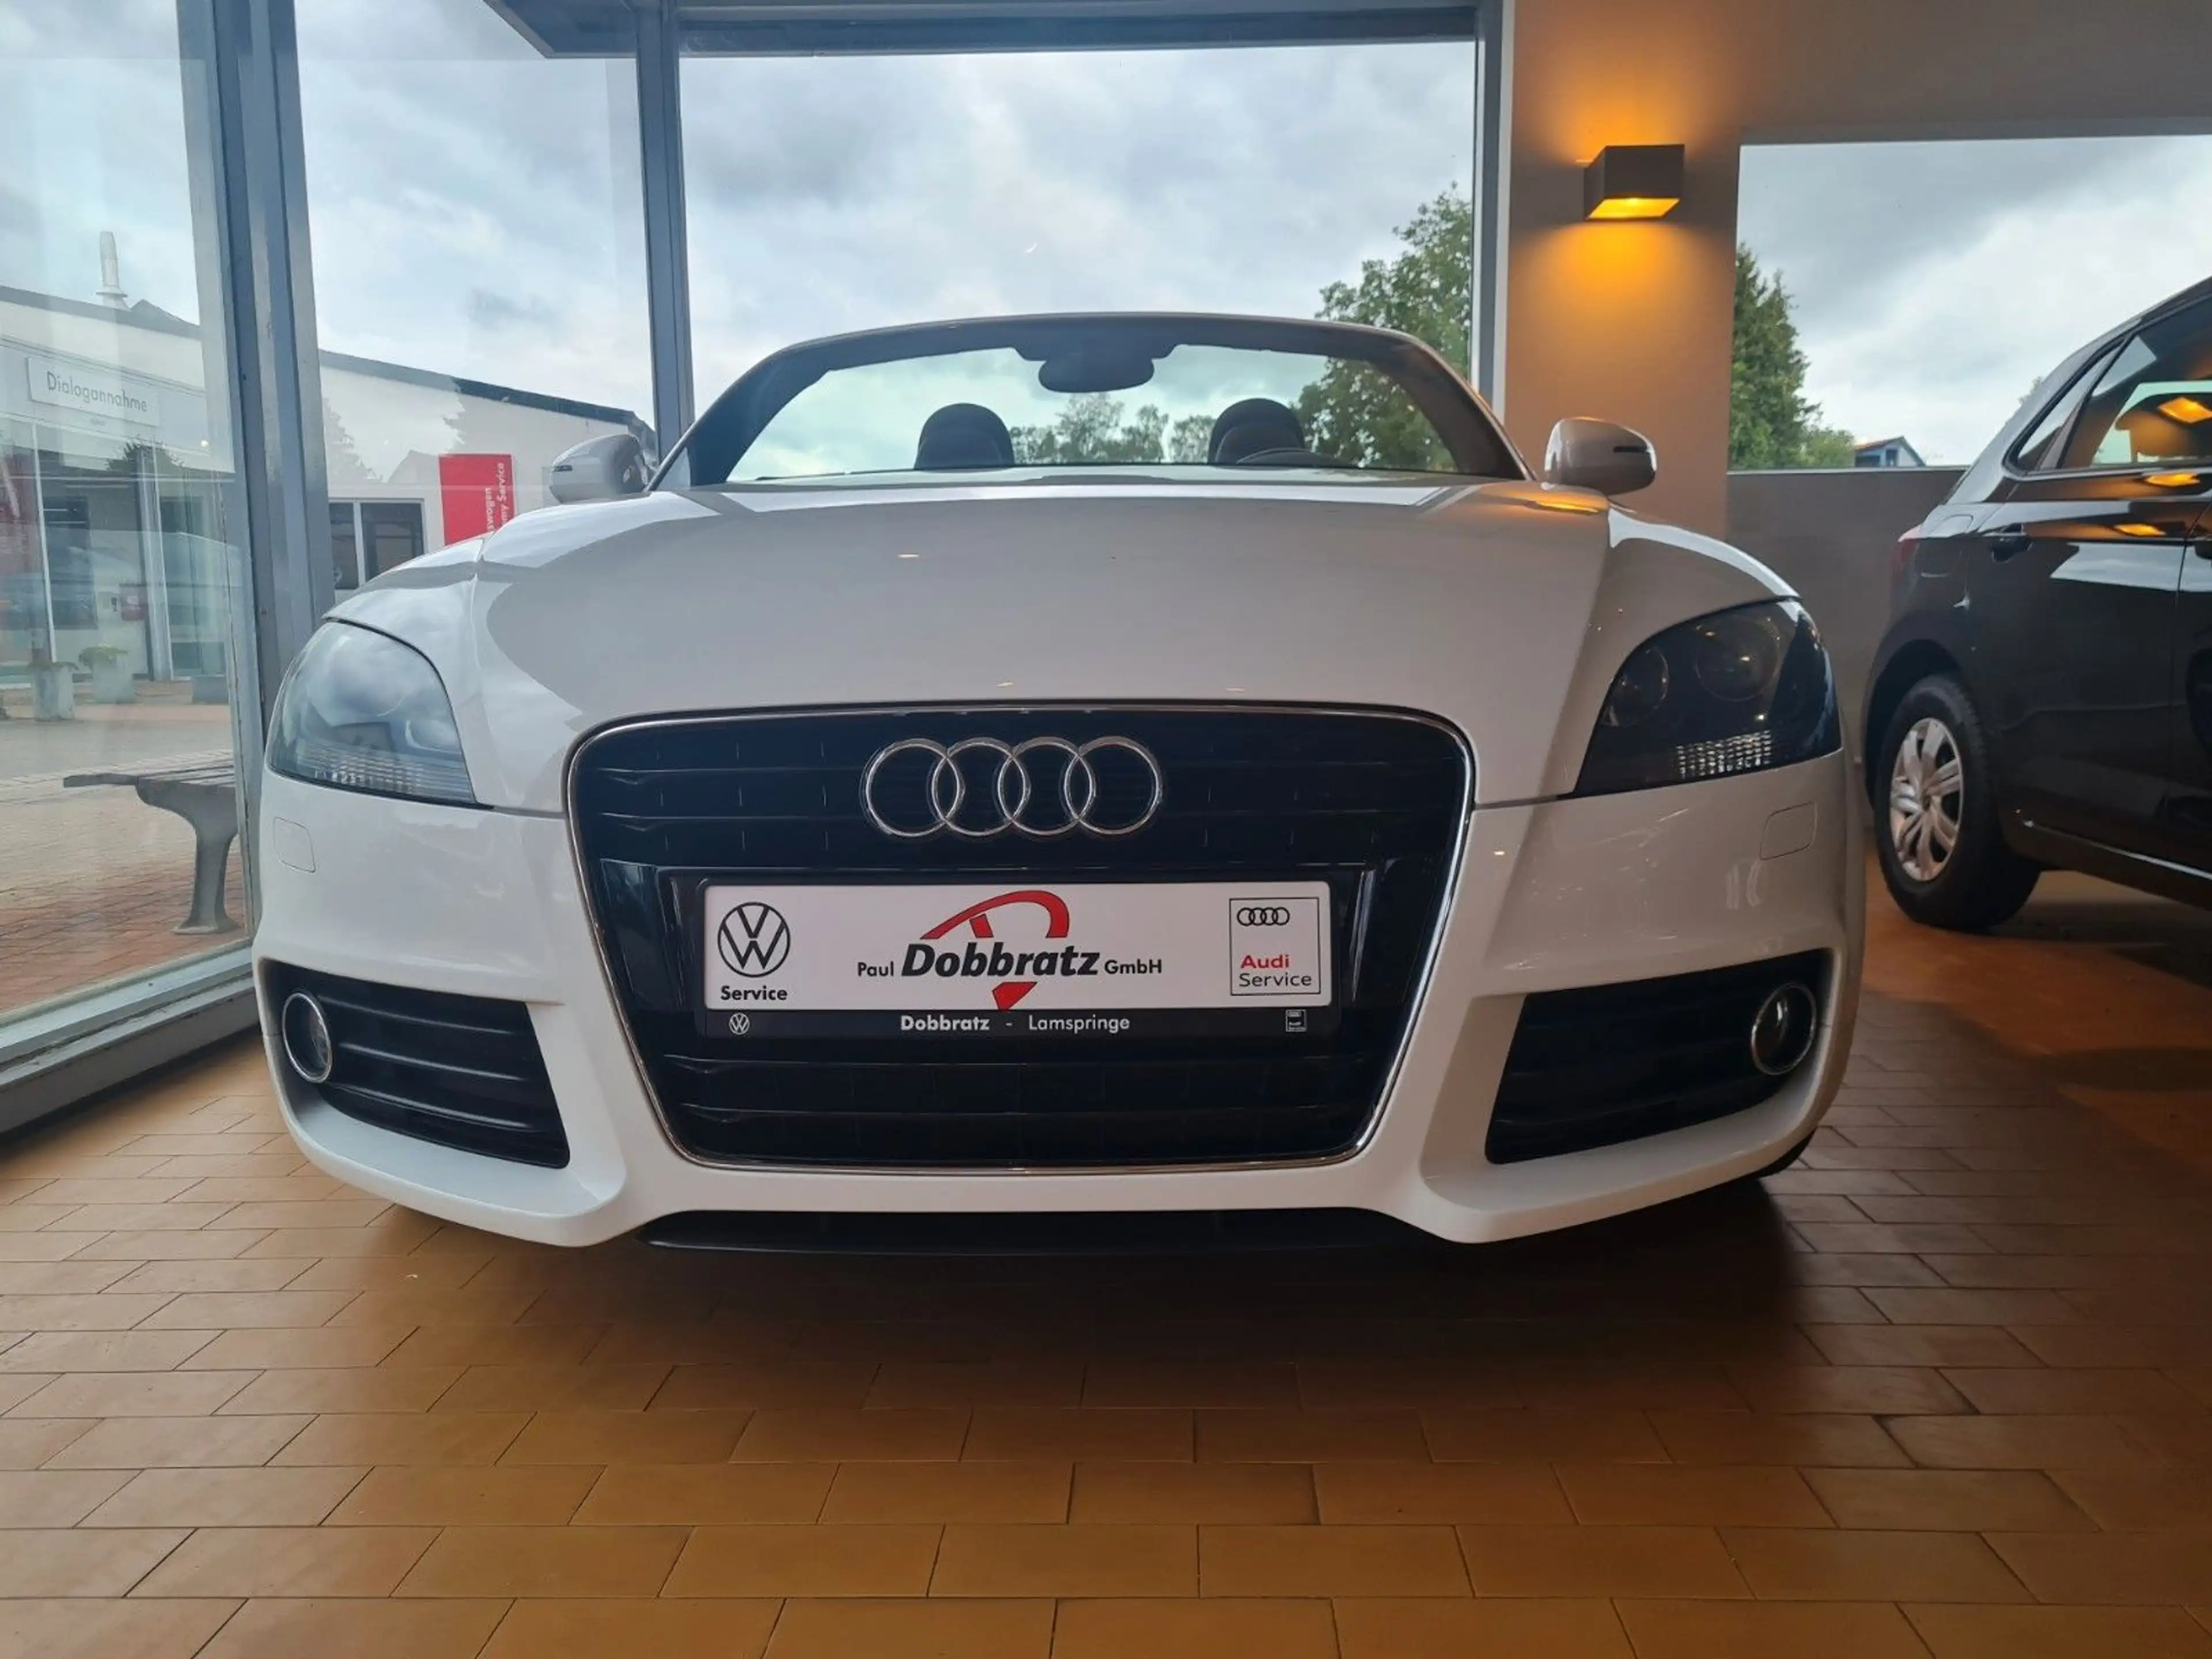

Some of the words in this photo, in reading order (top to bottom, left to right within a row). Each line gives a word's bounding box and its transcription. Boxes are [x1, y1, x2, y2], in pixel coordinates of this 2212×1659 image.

[47, 370, 147, 412] Dialogannahme
[495, 462, 507, 501] Service
[857, 961, 894, 977] Paul
[901, 942, 1100, 978] Dobbratz
[1104, 959, 1162, 975] GmbH
[1240, 954, 1290, 969] Audi
[1239, 972, 1312, 987] Service
[720, 985, 788, 1001] Service
[900, 1014, 990, 1031] Dobbratz
[1029, 1014, 1130, 1034] Lamspringe
